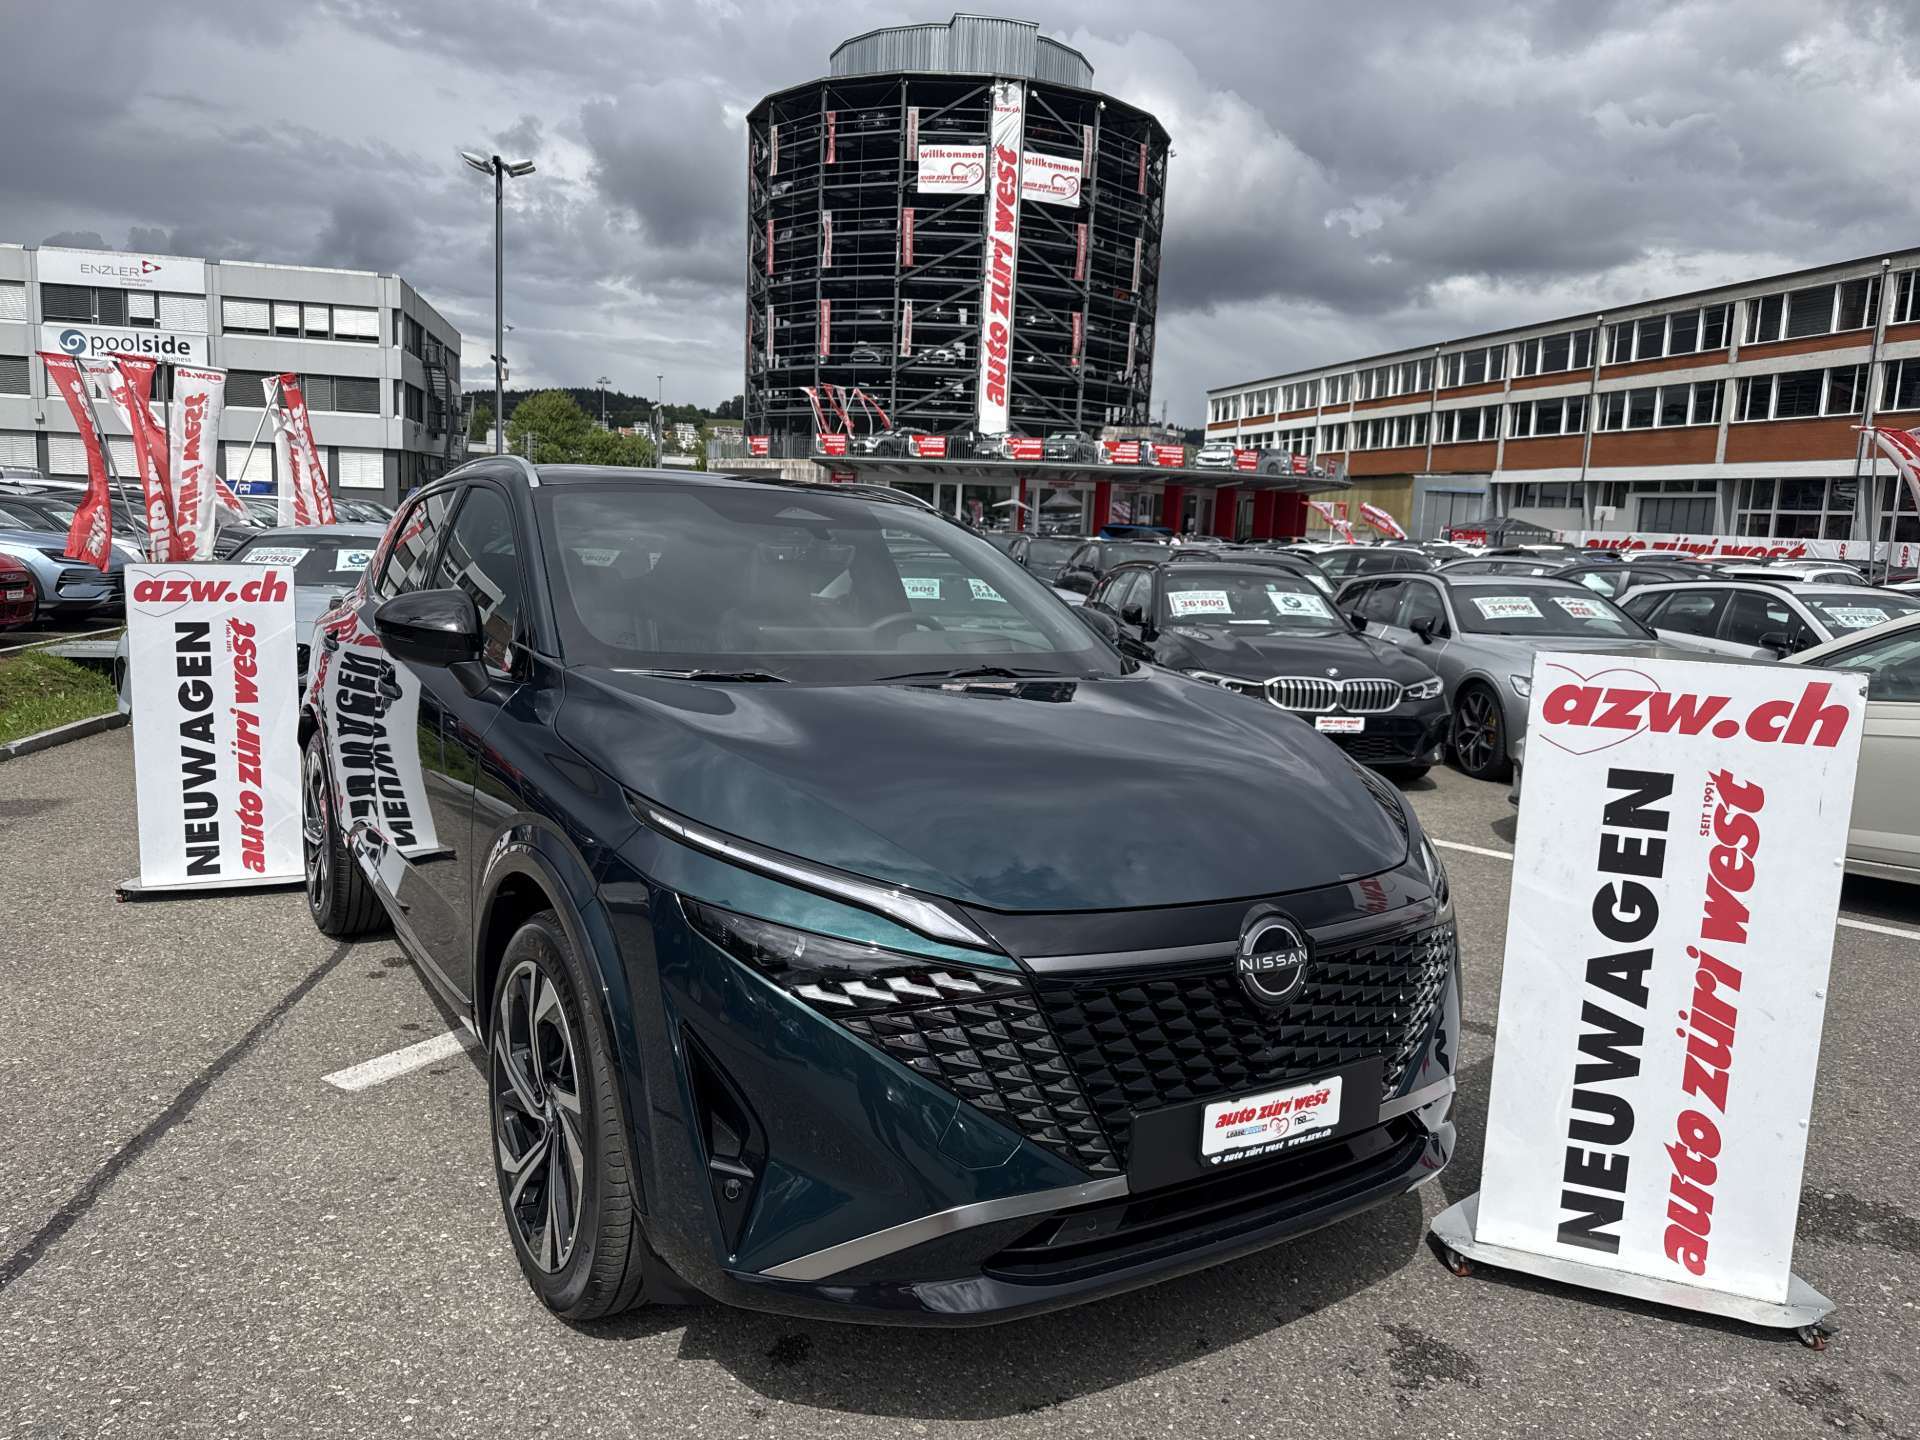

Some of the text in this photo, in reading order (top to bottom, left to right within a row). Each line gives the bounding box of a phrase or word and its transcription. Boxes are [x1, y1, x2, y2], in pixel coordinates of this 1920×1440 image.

[920, 149, 984, 159] willkommen
[1024, 157, 1080, 173] willkommen
[80, 263, 140, 277] ENZLER
[984, 144, 1018, 406] auto züri west
[90, 333, 191, 356] poolside
[250, 555, 297, 563] 30'550
[133, 570, 288, 603] azw.ch
[1180, 599, 1224, 608] 36'800
[1542, 681, 1850, 747] azw.ch
[175, 621, 221, 877] NEUWAGEN
[225, 616, 265, 873] auto züri west
[1699, 780, 1715, 838] SEIT 1991
[1239, 949, 1308, 971] NISSAN
[1556, 767, 1675, 1255] NEUWAGEN
[1662, 768, 1766, 1276] auto züri west
[1215, 1088, 1331, 1129] auto züri west
[1223, 1152, 1243, 1163] auto
[1264, 1141, 1285, 1153] west
